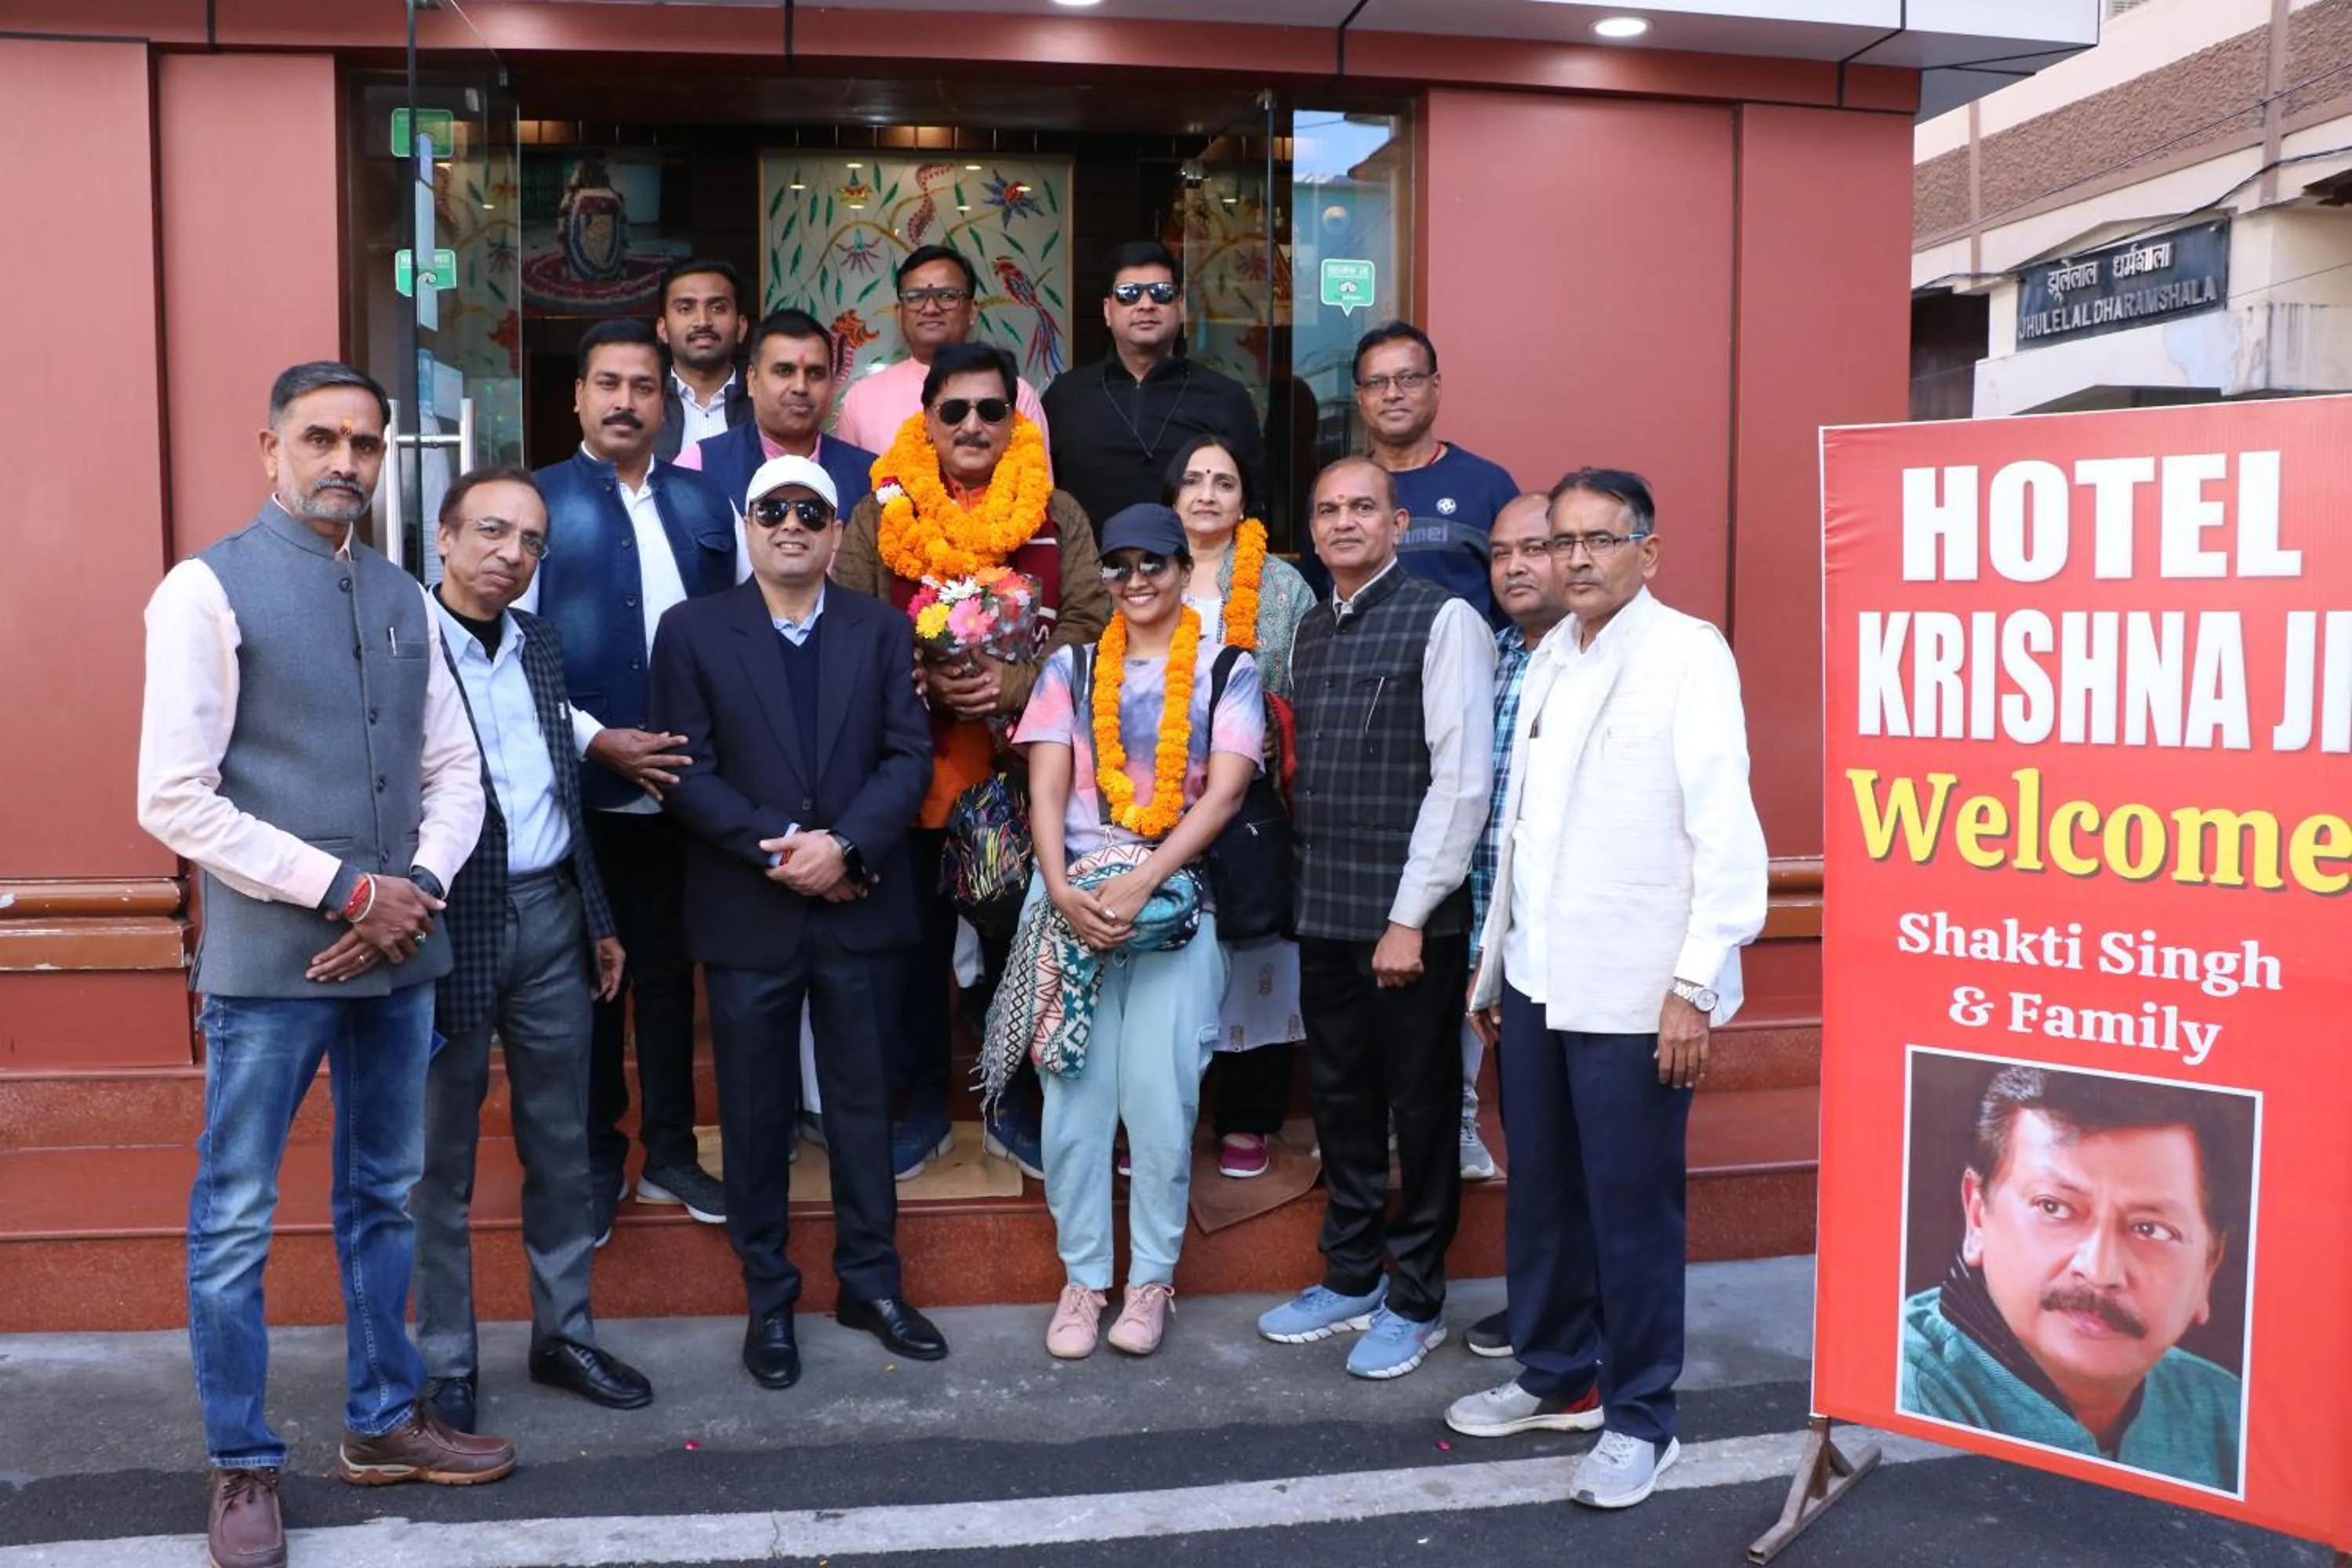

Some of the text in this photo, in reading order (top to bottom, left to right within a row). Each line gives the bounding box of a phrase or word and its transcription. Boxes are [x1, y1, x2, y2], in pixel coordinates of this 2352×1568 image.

[2017, 276, 2218, 339] JHULELAL DHARAMSHALA
[2047, 258, 2099, 303] झूलेलाल
[1903, 450, 2303, 582] HOTEL
[1858, 609, 2352, 753] KRISHNA JI
[1846, 768, 2352, 893] Welcome
[1897, 911, 2283, 996] Shakti Singh
[1948, 985, 2223, 1065] & Family
